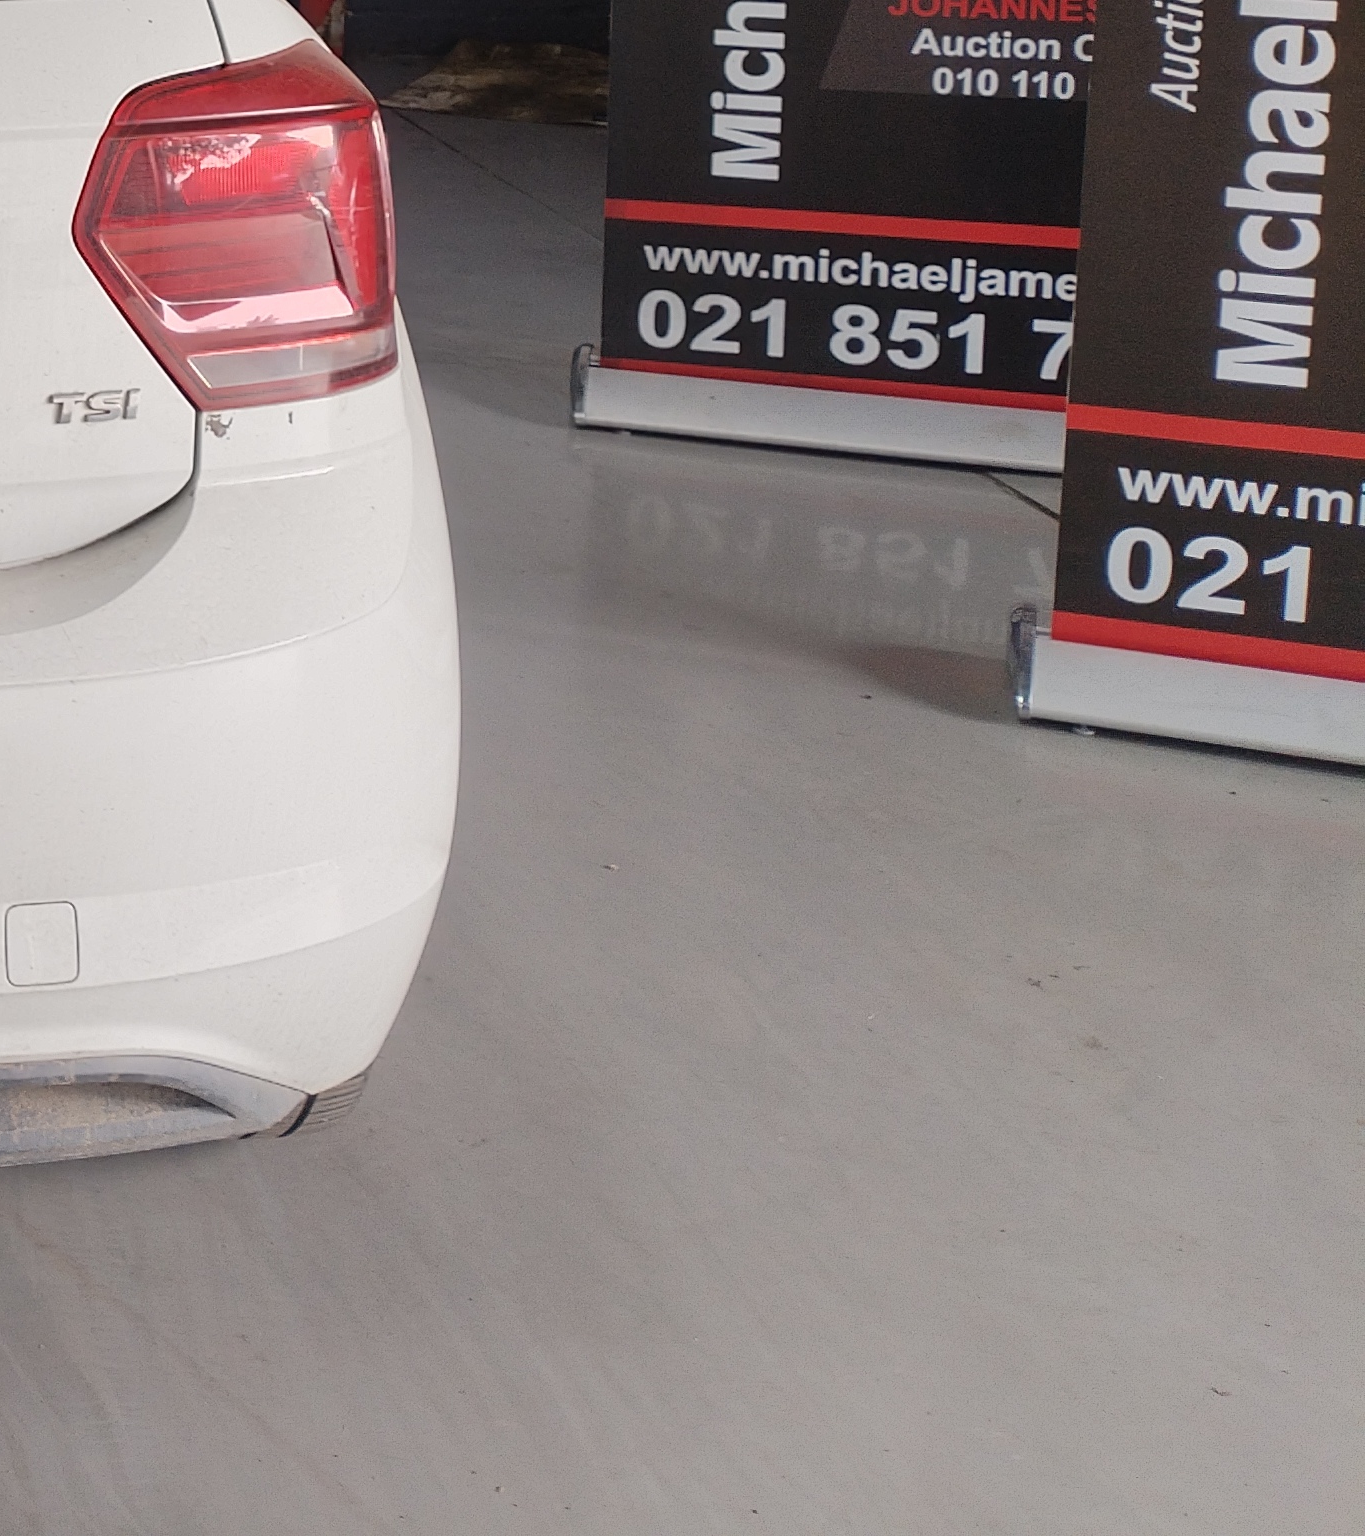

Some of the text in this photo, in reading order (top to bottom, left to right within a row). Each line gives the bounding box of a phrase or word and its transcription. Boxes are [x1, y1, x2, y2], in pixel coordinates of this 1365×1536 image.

[910, 27, 1061, 60] Auction
[932, 66, 1076, 100] 010 110
[637, 289, 786, 358] 021
[829, 304, 986, 375] 851
[47, 388, 141, 424] TSI
[1107, 526, 1311, 623] 021
